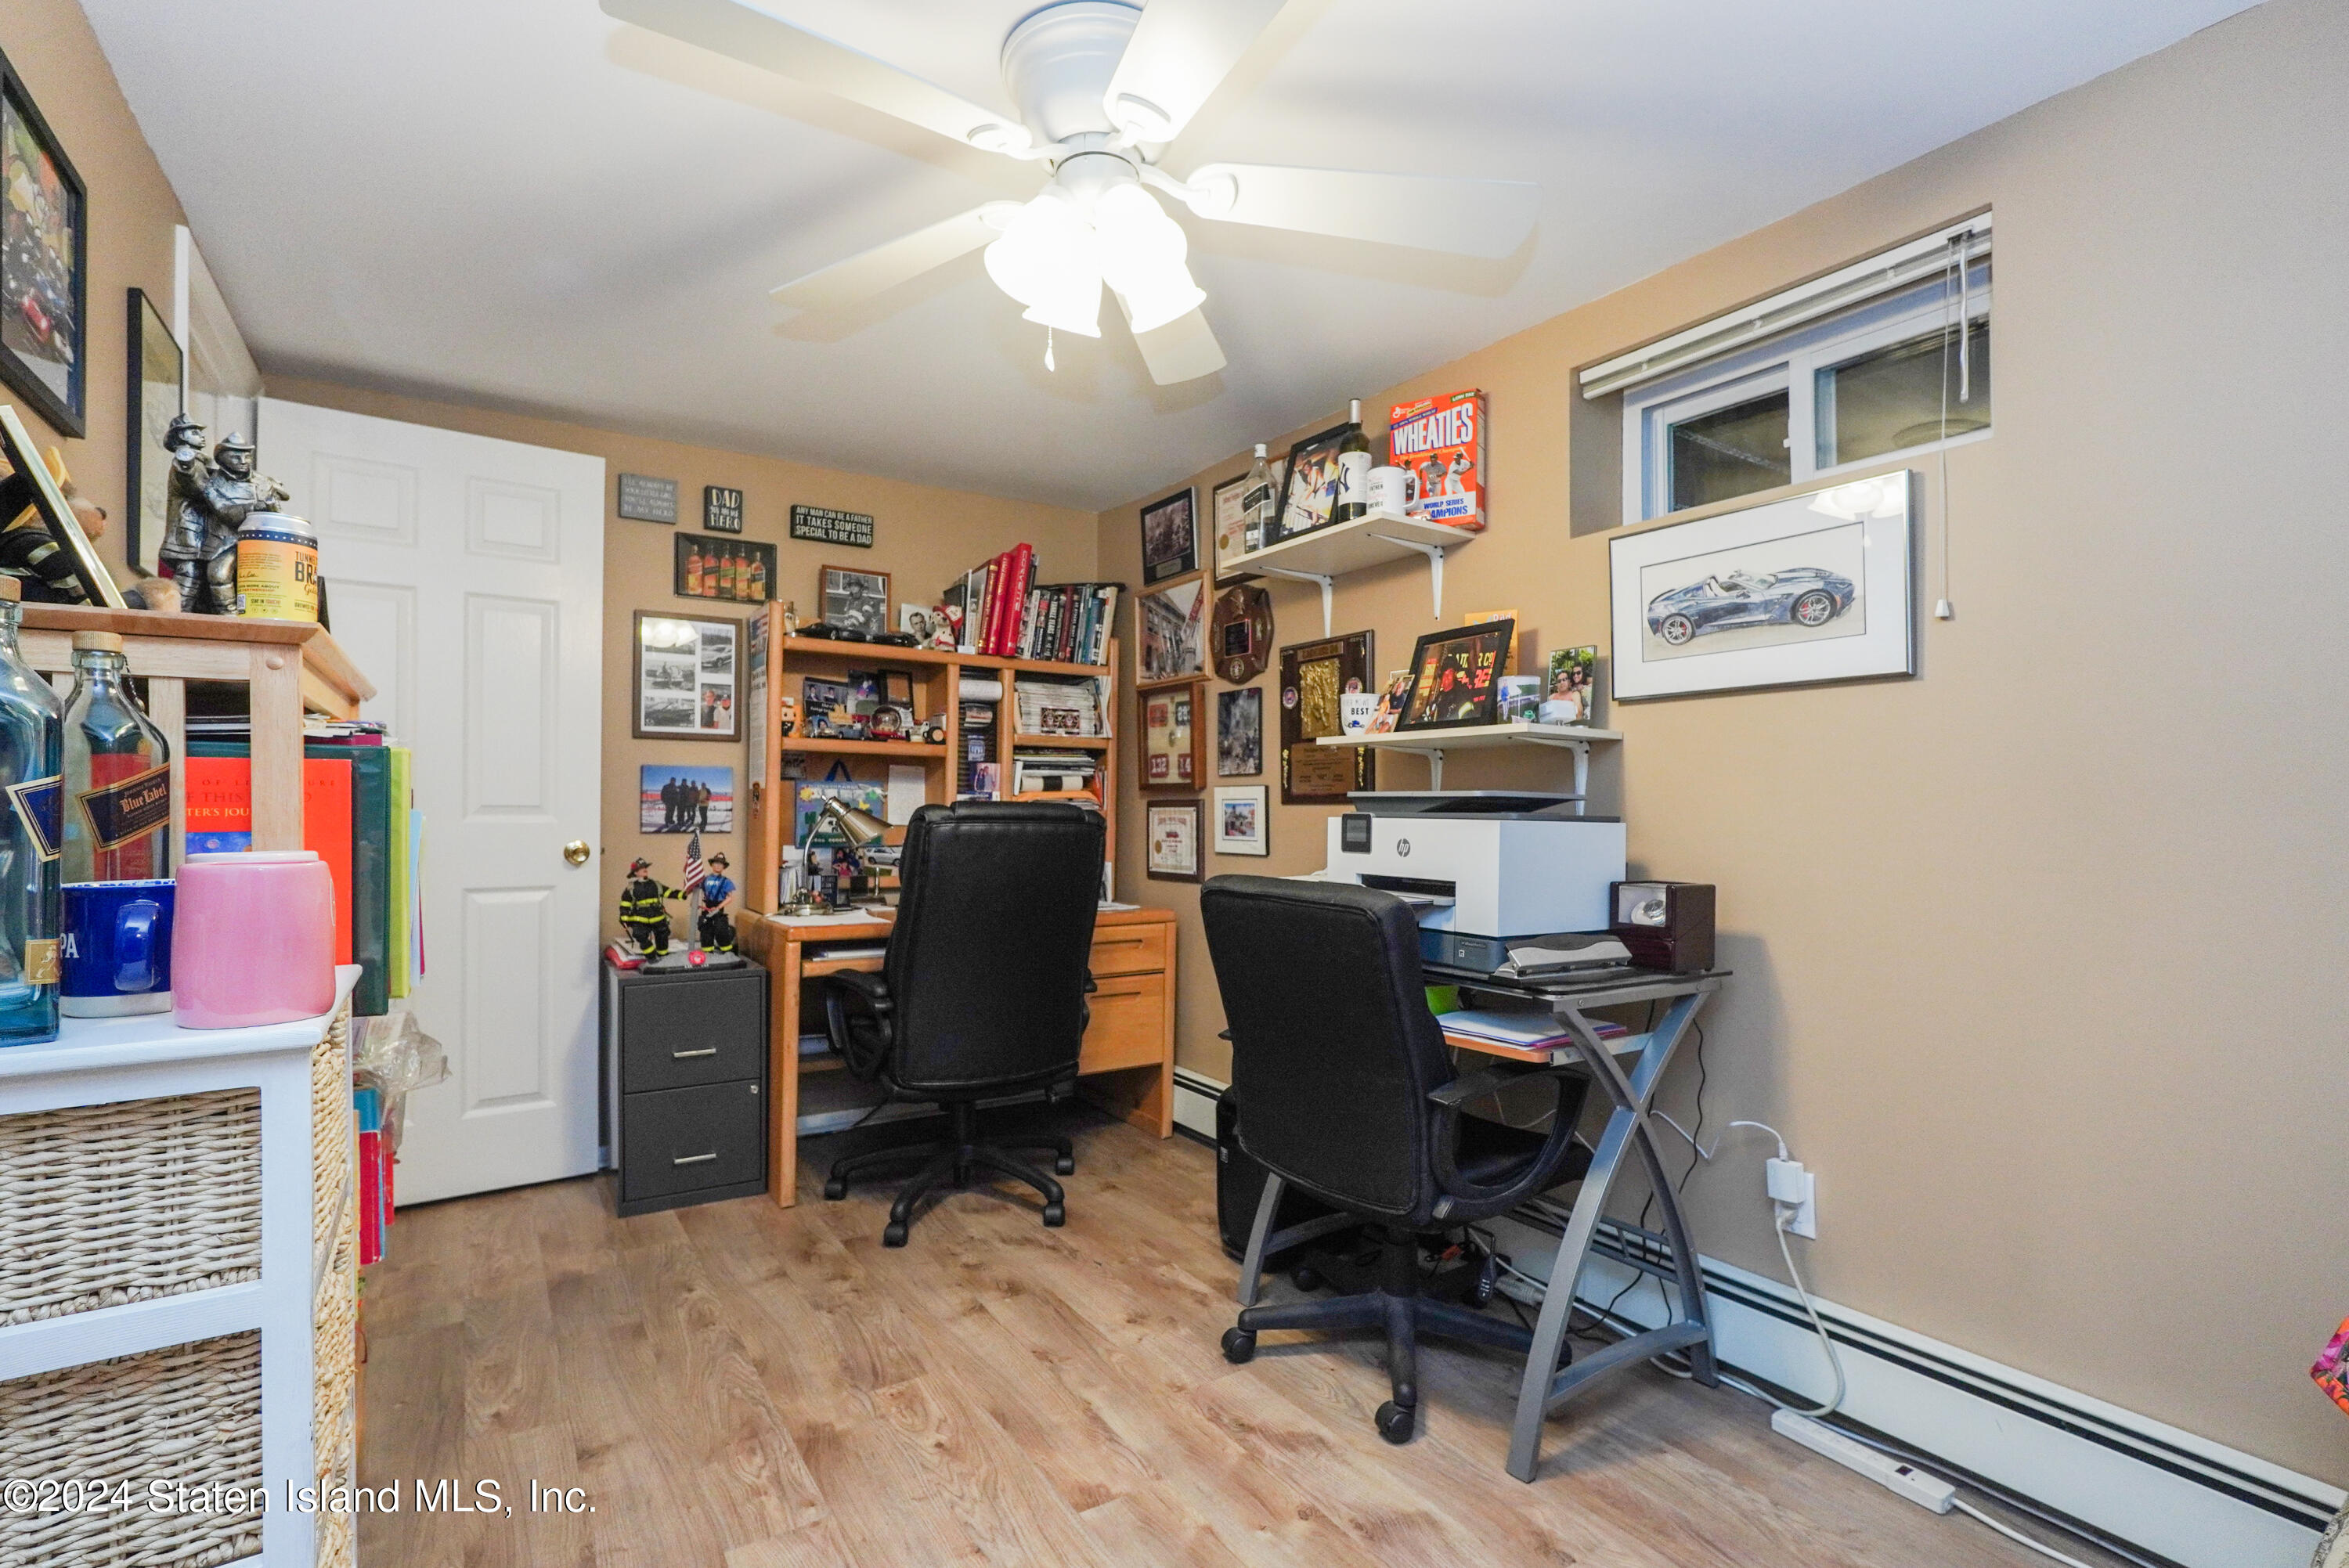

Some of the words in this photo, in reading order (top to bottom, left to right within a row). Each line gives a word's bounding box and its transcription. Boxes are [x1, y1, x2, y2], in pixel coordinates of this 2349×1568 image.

[1394, 402, 1474, 456] WHEATIES
[712, 488, 740, 508] DAD
[1423, 500, 1444, 510] WORLD
[1445, 498, 1464, 506] SERIES
[796, 506, 809, 515] ANY
[810, 508, 824, 517] MAN
[824, 510, 836, 519] CAN
[837, 512, 846, 521] BE
[850, 514, 873, 524] FATHER
[1431, 505, 1468, 518] AMPIONS
[710, 514, 741, 530] HERO
[796, 515, 804, 524] IT
[806, 516, 832, 528] TAKES
[834, 520, 873, 535] SOMEONE
[796, 524, 827, 539] SPECIAL
[828, 529, 838, 540] TO
[839, 531, 849, 541] BE
[857, 533, 871, 544] DAD
[1015, 550, 1027, 611] CORVETTE
[119, 796, 144, 814] Blue
[143, 783, 167, 803] Label
[203, 791, 243, 802] THIS
[188, 807, 220, 816] TER'S
[1398, 838, 1410, 857] hp
